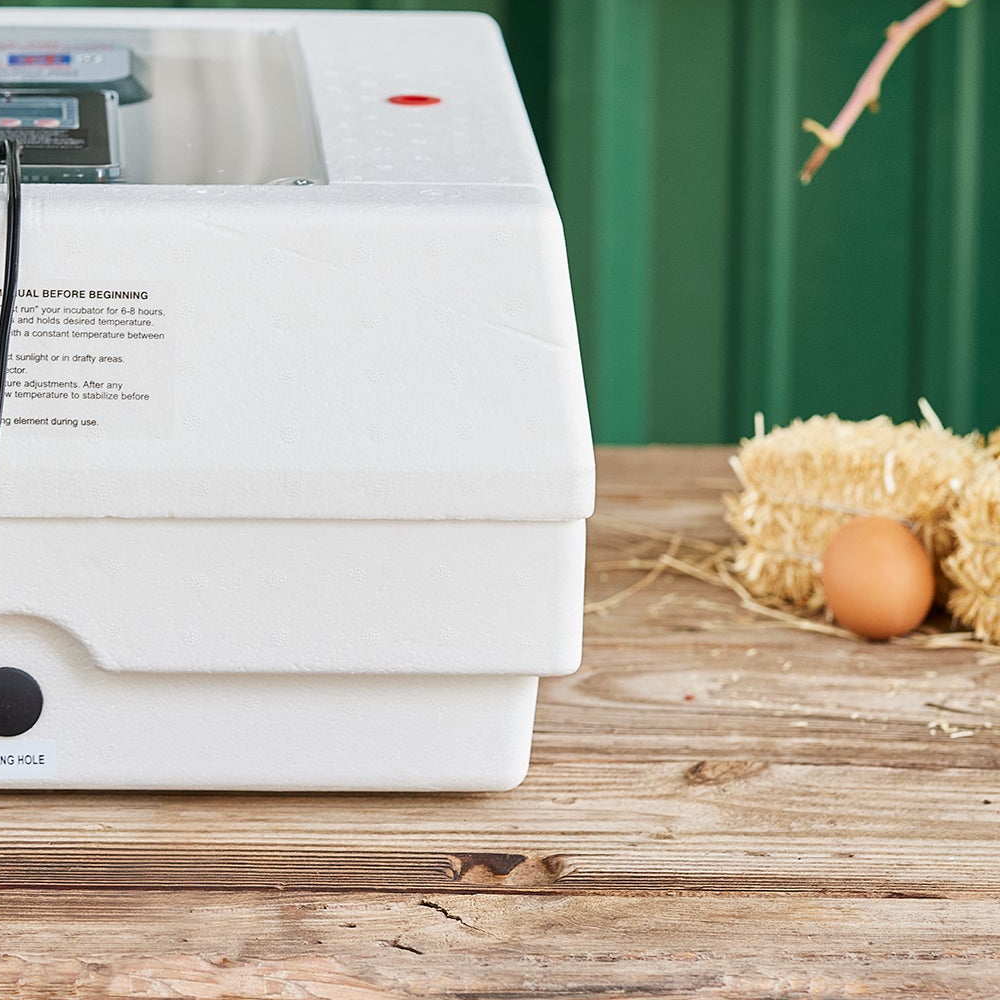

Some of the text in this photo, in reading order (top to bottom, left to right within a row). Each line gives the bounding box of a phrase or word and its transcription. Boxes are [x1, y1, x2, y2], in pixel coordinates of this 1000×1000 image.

[42, 289, 86, 299] BEFORE
[89, 290, 149, 300] BEGINNING
[41, 307, 60, 315] your
[63, 306, 104, 314] incubator
[107, 307, 118, 315] for
[120, 307, 136, 315] 6-8
[17, 316, 34, 325] and
[36, 317, 60, 325] holds
[63, 317, 96, 326] desired
[98, 318, 154, 328] temperature.
[11, 329, 22, 337] ith
[32, 330, 70, 338] constant
[71, 331, 125, 339] temperature
[127, 331, 165, 340] between
[15, 353, 49, 363] sunlight
[62, 354, 70, 362] in
[72, 354, 96, 364] drafty
[83, 380, 104, 389] After
[106, 382, 124, 391] any
[14, 391, 69, 400] temperature
[82, 392, 118, 400] stabilize
[121, 392, 150, 401] before
[13, 417, 49, 425] element
[51, 417, 78, 427] during
[17, 754, 45, 765] HOLE
